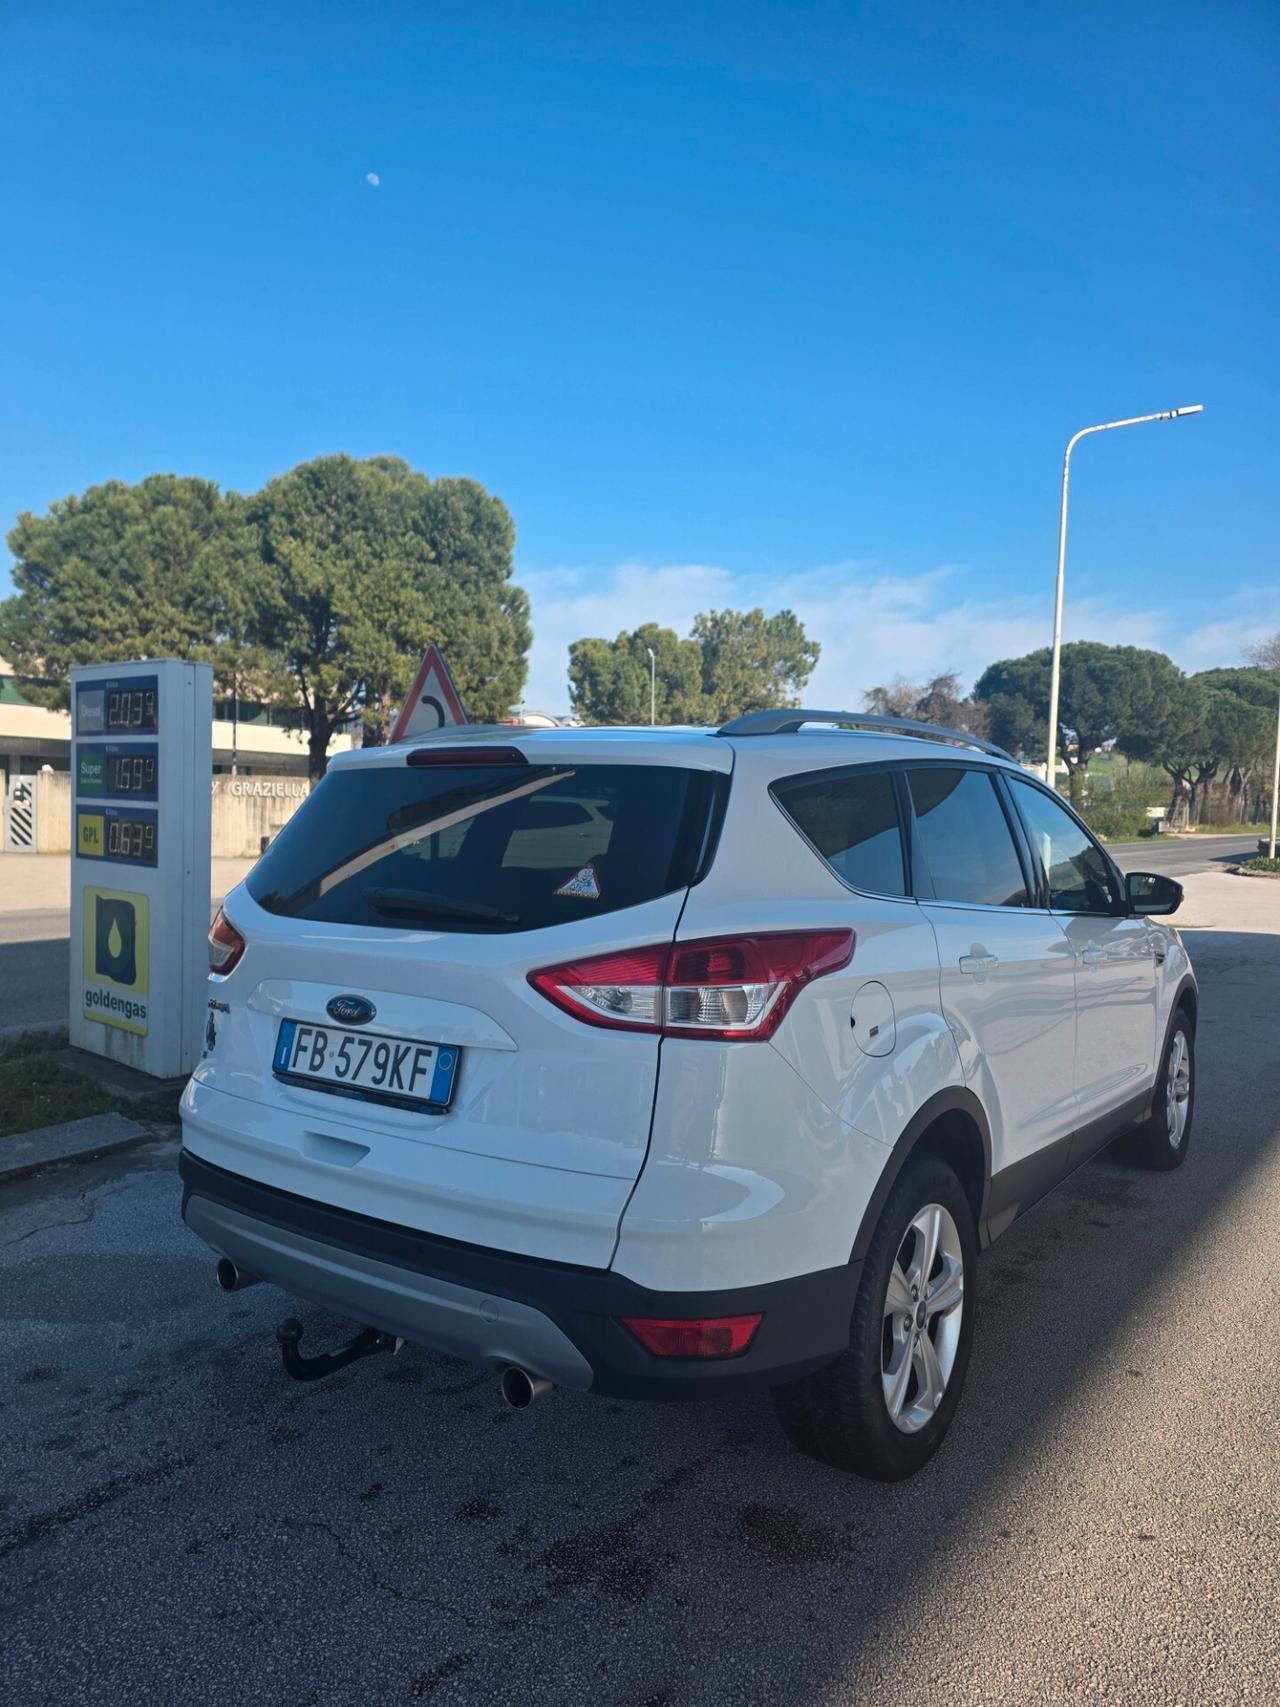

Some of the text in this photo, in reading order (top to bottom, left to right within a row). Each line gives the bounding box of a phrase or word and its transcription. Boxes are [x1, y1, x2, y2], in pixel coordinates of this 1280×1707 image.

[81, 761, 101, 776] Super
[231, 782, 310, 798] GRAZIELLA
[83, 826, 99, 843] GPL
[85, 989, 147, 1020] goldengas
